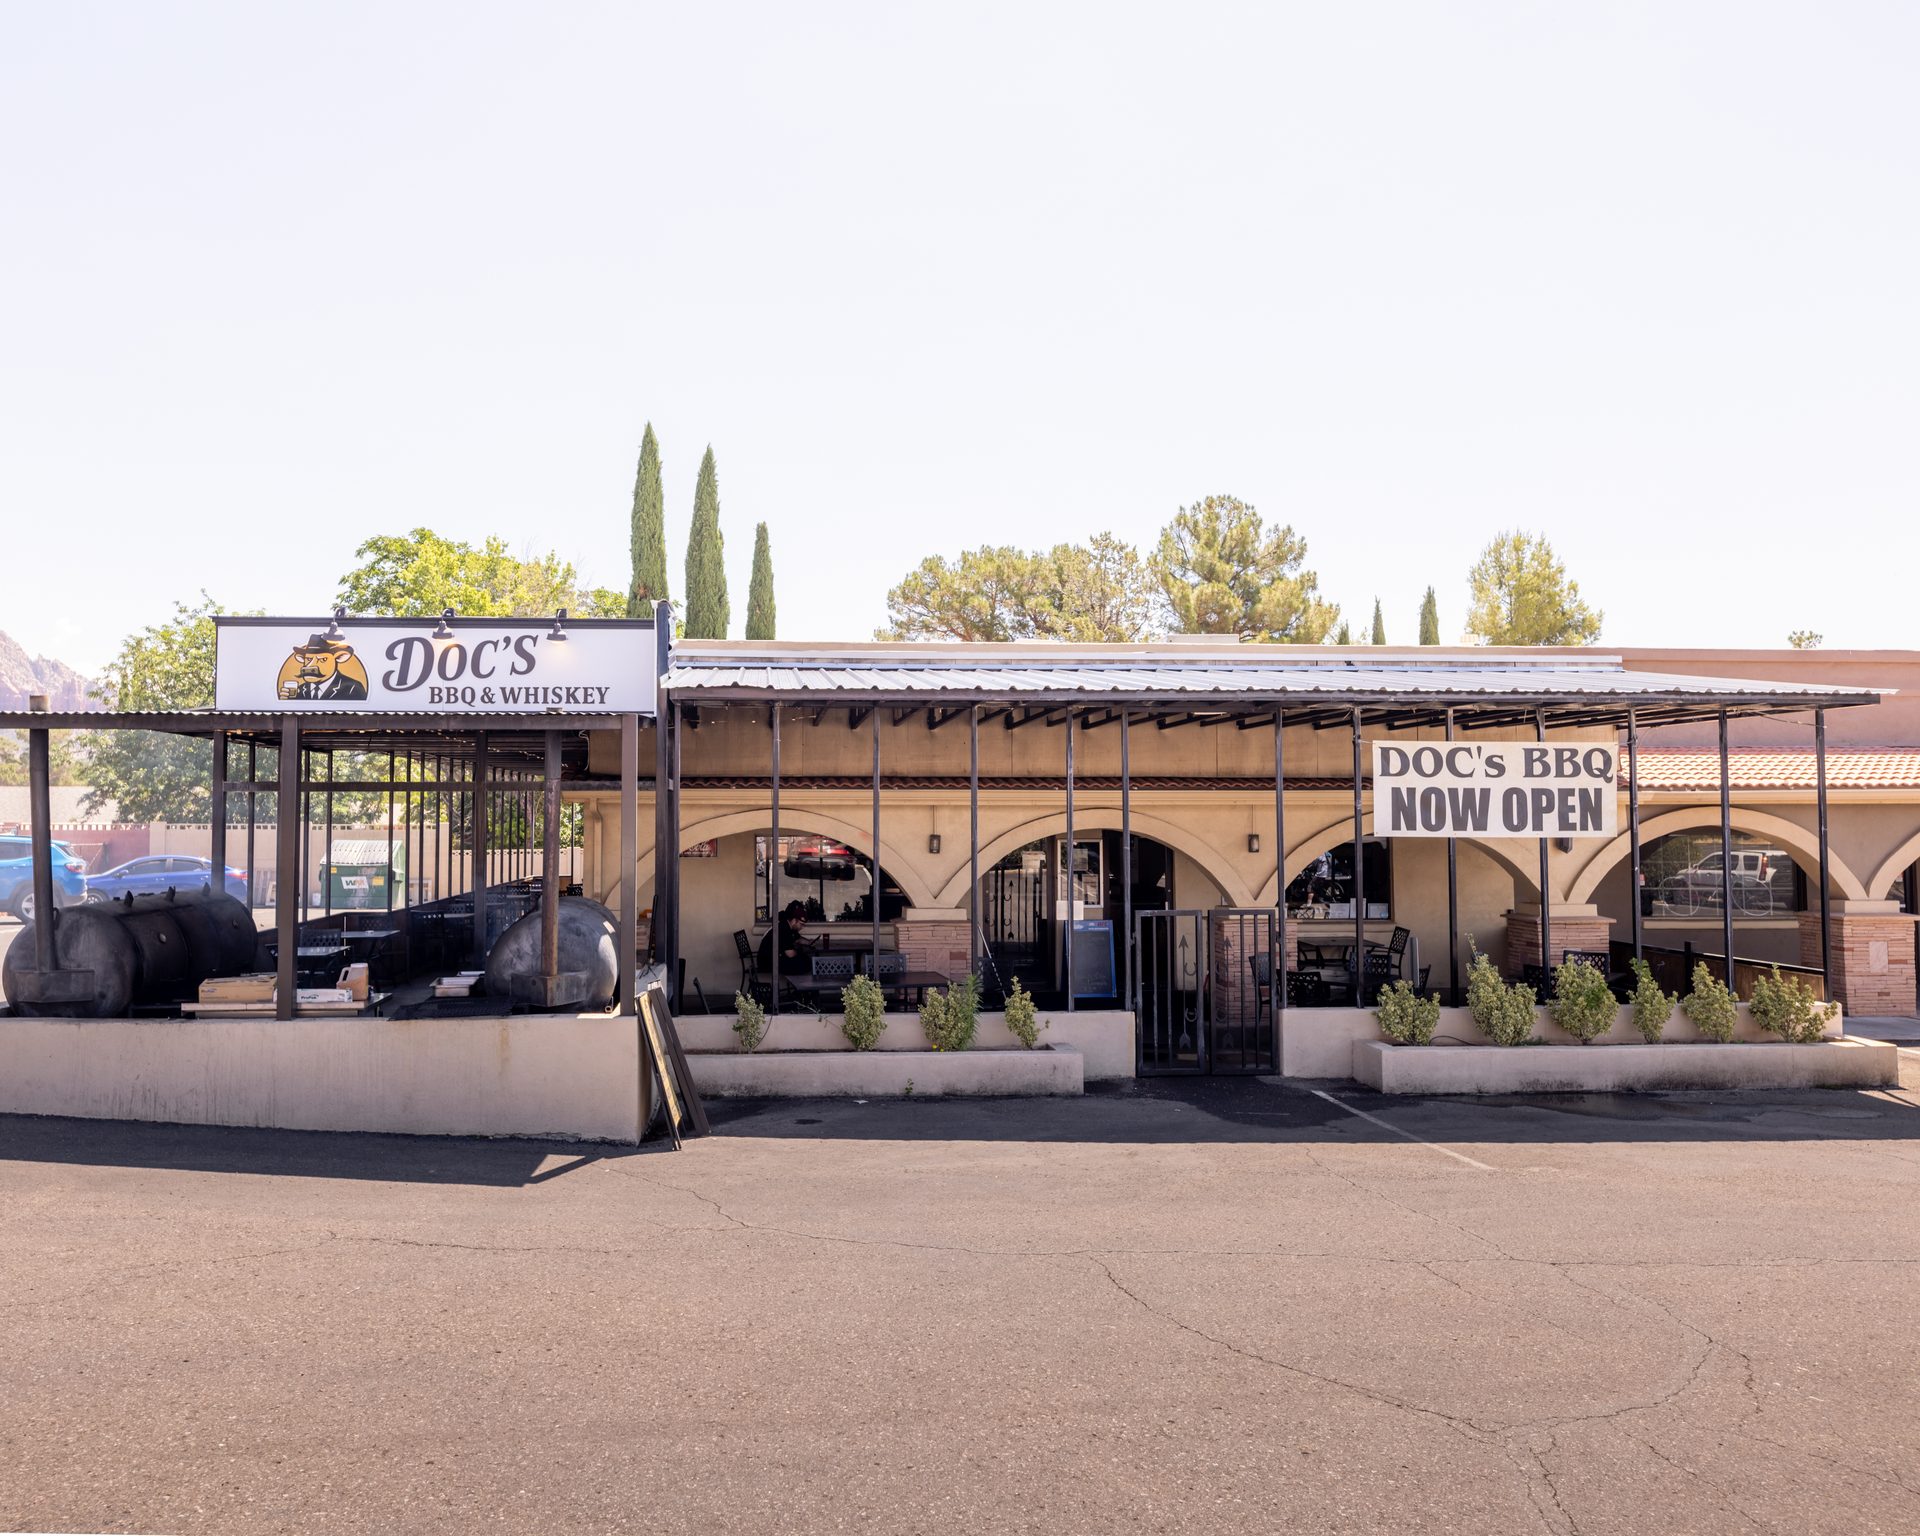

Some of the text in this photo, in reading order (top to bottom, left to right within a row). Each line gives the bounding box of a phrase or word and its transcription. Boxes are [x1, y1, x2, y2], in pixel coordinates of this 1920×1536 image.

[429, 686, 611, 707] BBQ & WHISKEY
[1378, 745, 1613, 784] DOC's BBQ
[1391, 786, 1603, 832] NOW OPEN
